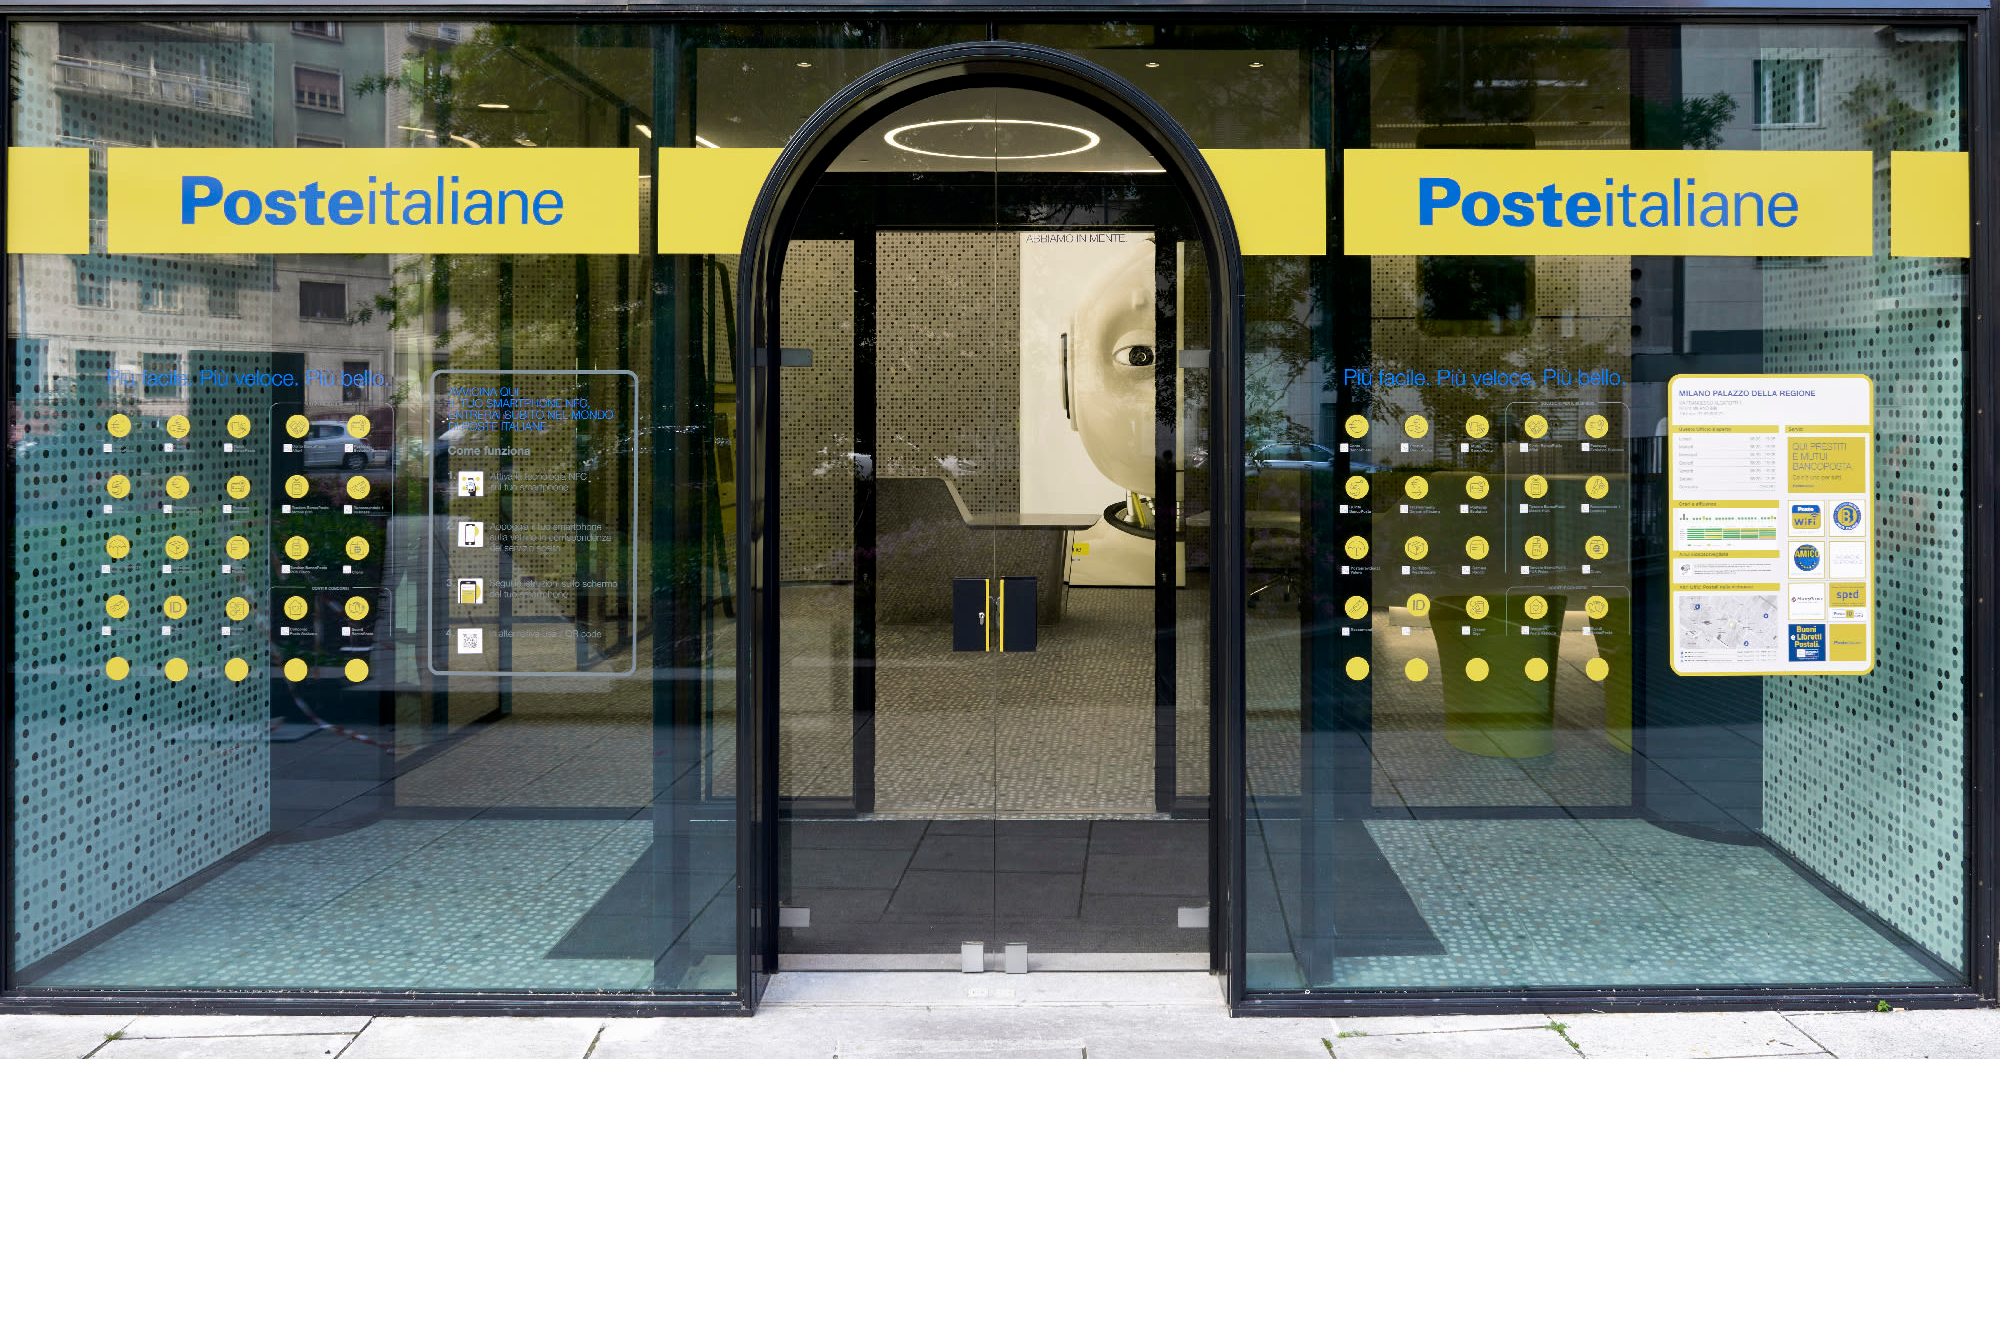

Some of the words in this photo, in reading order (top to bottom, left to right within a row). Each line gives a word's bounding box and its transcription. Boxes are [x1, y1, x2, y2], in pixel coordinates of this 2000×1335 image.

[181, 175, 563, 226] Posteitaliane
[1418, 177, 1799, 228] Posteitaliane
[1026, 233, 1074, 243] ABBIAMO
[1076, 233, 1087, 243] IN
[107, 369, 136, 387] Più
[142, 369, 193, 387] facile.
[200, 369, 229, 387] Più
[236, 369, 299, 387] veloce.
[306, 369, 335, 387] Più
[341, 369, 390, 387] bello.
[1344, 369, 1372, 386] Più
[1379, 369, 1430, 386] facile.
[1437, 369, 1466, 386] Più
[1472, 369, 1536, 386] veloce.
[1544, 369, 1572, 386] Più
[1578, 369, 1626, 386] bello.
[448, 387, 498, 397] AVVICINA
[500, 387, 519, 397] QUI
[461, 398, 483, 408] TUO
[486, 398, 563, 408] SMARTPHONE
[448, 410, 501, 420] ENTRERAI
[504, 410, 545, 420] SUBITO
[547, 410, 568, 420] NEL
[571, 410, 614, 420] MONDO
[462, 421, 498, 431] POSTE
[500, 421, 547, 431] ITALIANE
[448, 446, 479, 456] Come
[483, 446, 531, 456] funziona
[1792, 443, 1808, 451] QUI
[1810, 443, 1847, 451] PRESTITI
[1792, 452, 1798, 461] E
[1801, 452, 1828, 461] MUTUI
[568, 472, 588, 481] NFC
[520, 483, 569, 492] smartphone
[552, 523, 602, 532] smartphone
[1794, 550, 1820, 558] AMICO
[560, 580, 580, 588] sullo
[582, 580, 618, 588] schermo
[520, 590, 569, 599] smartphone
[581, 630, 602, 638] code
